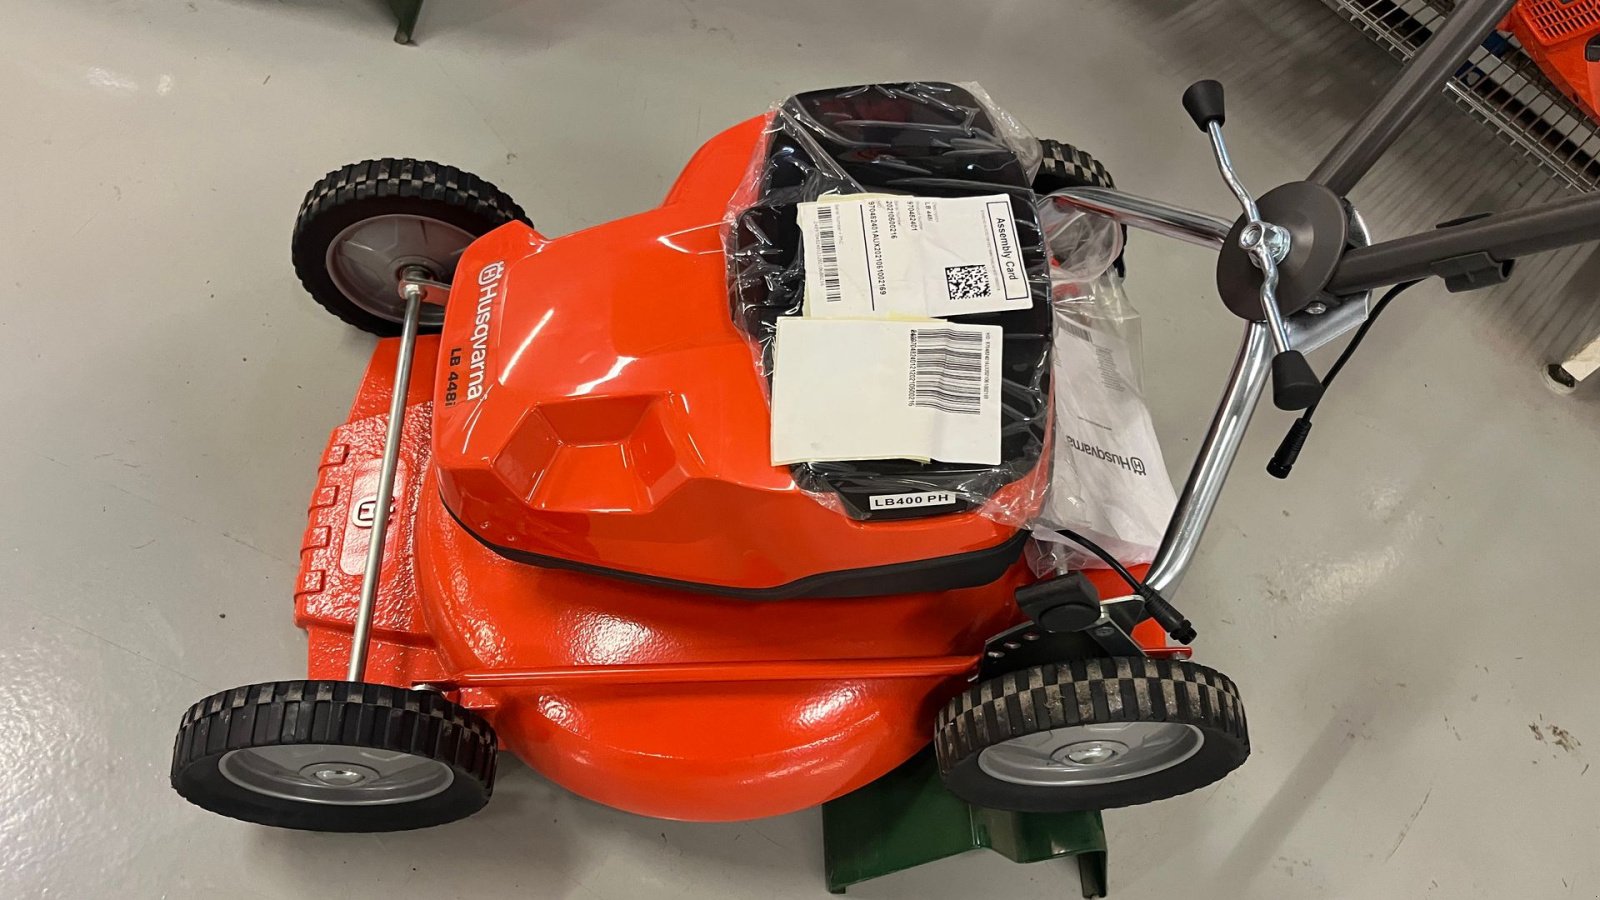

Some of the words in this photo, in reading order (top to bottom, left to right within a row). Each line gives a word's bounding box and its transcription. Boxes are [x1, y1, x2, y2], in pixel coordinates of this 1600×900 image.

[996, 217, 1011, 259] Assembly
[1005, 261, 1019, 280] Card
[450, 348, 461, 367] LB
[467, 282, 498, 401] Husqvarna
[445, 371, 459, 407] 448i
[1066, 435, 1132, 471] Husqvarna
[875, 496, 923, 507] LB400
[927, 494, 949, 503] PH
